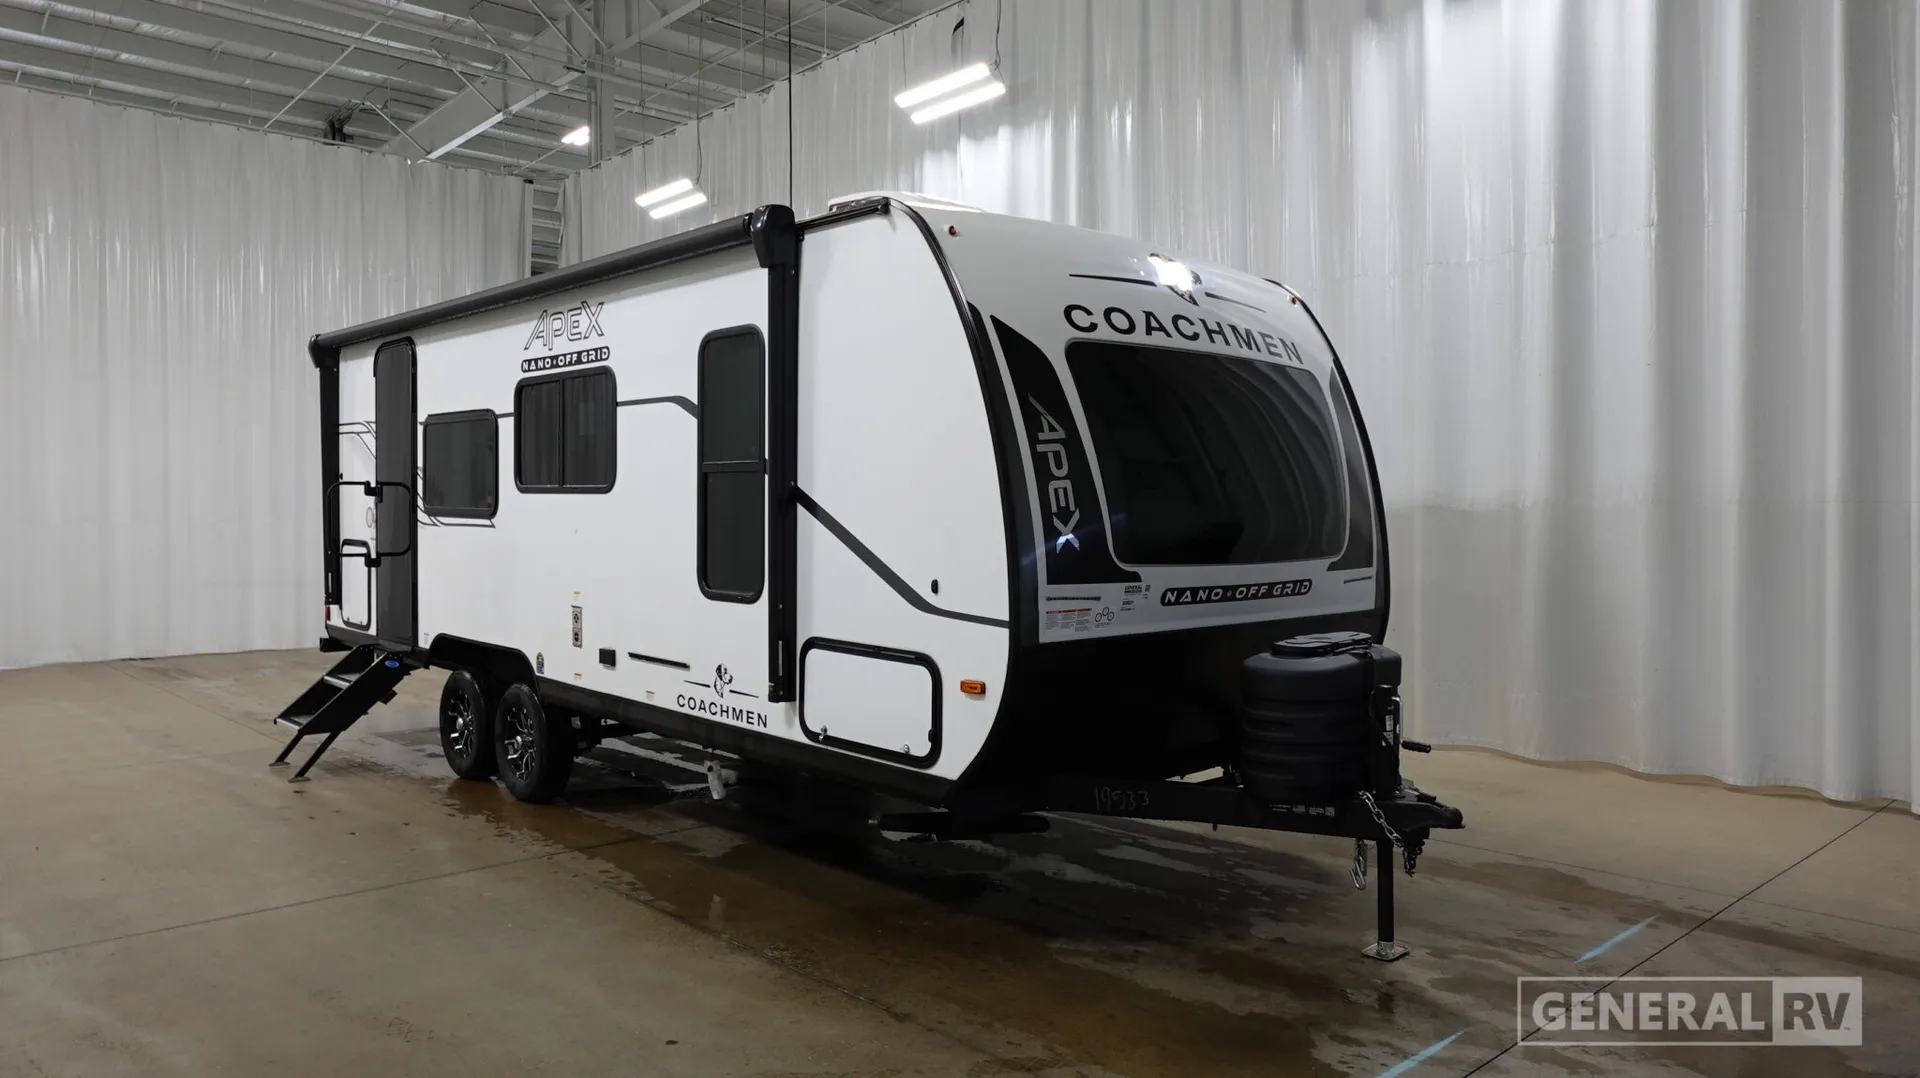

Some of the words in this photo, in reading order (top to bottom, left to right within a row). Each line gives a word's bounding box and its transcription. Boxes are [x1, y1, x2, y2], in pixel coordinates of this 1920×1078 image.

[524, 300, 605, 351] APEX
[1063, 304, 1304, 365] COACHMEN
[581, 348, 609, 362] GRID
[1028, 393, 1080, 554] APEX
[1272, 581, 1310, 596] GRID
[676, 694, 767, 728] COACHMEN
